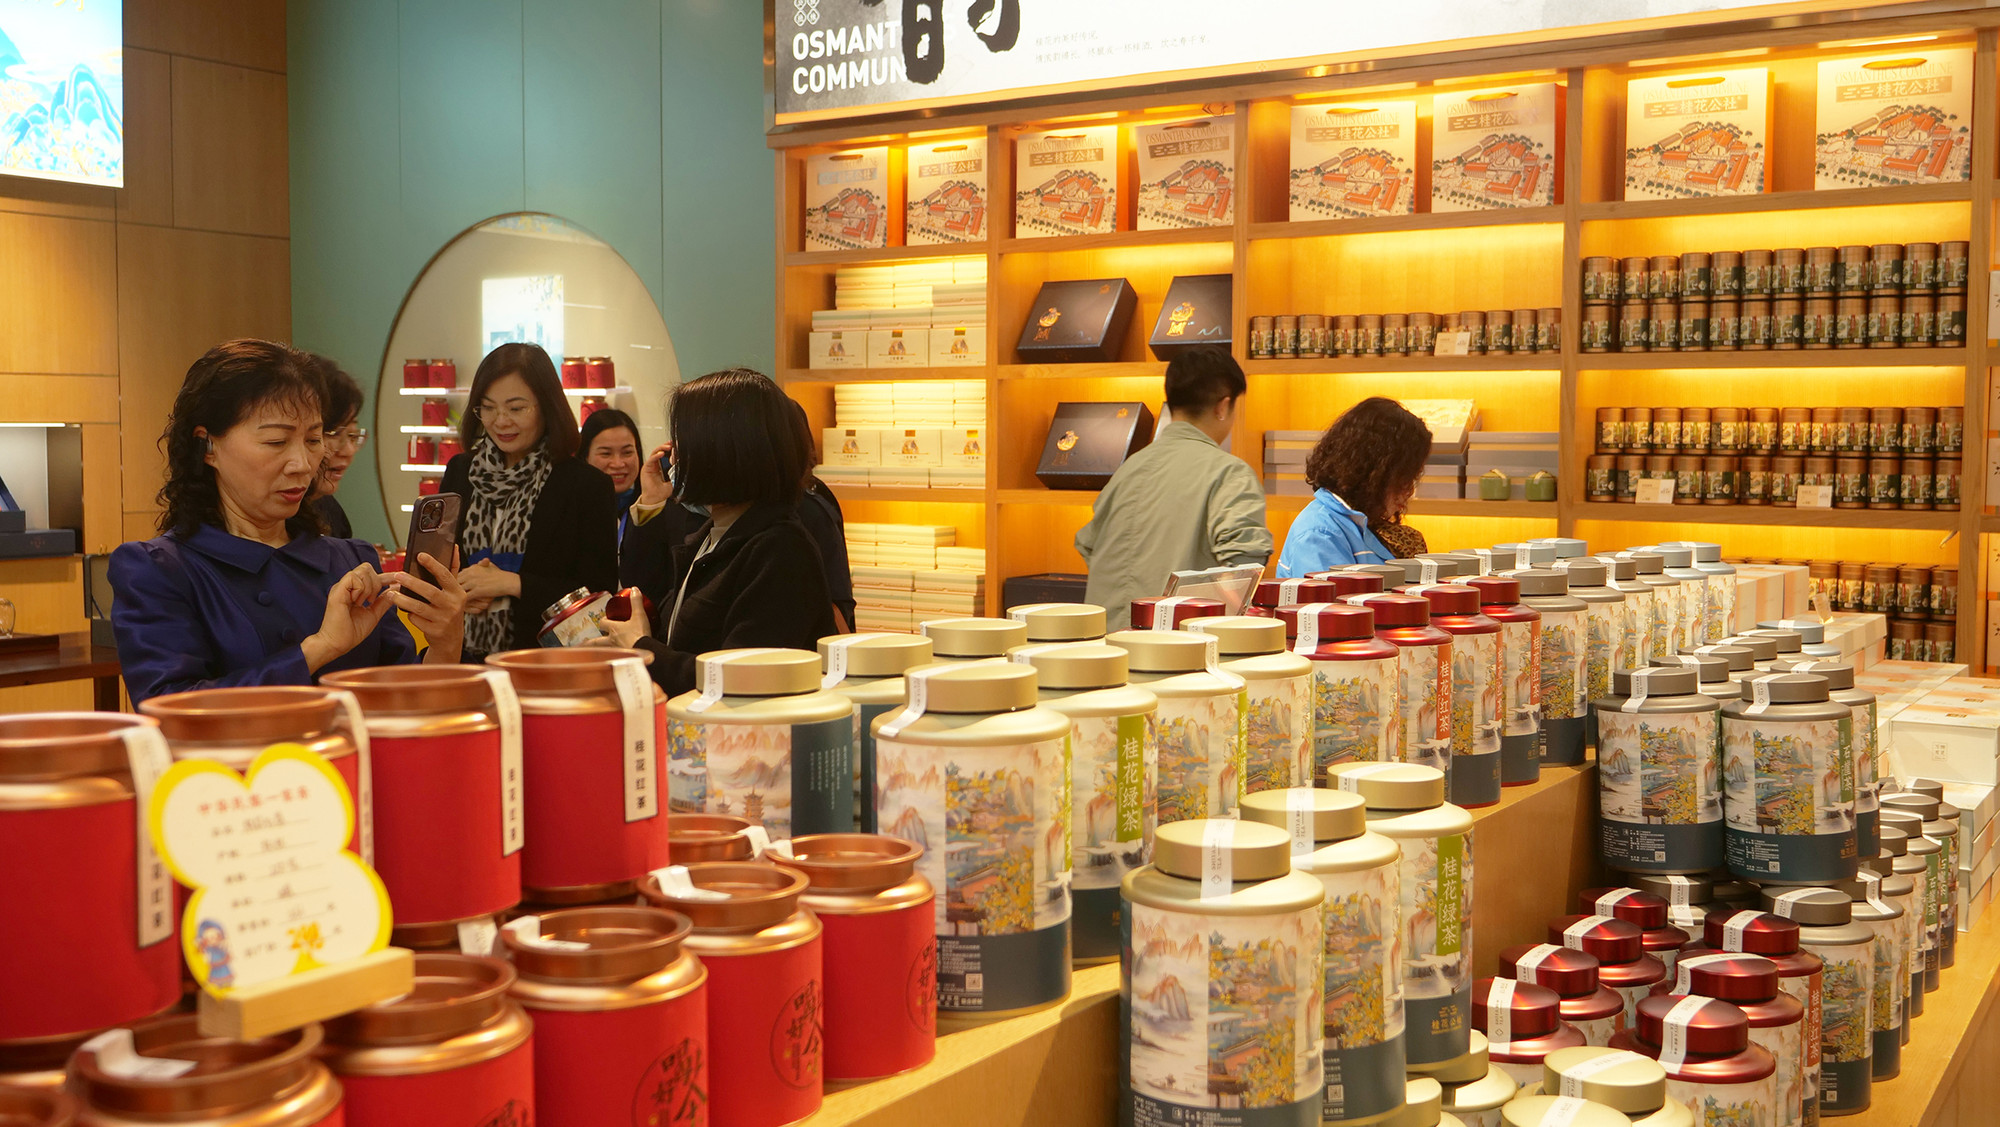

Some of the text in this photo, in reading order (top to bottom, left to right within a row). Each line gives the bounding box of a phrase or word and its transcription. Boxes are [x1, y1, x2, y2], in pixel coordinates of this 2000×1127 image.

[1439, 660, 1450, 732] 桂花红茶
[1121, 736, 1139, 832] 桂花绿茶
[1441, 856, 1458, 946] 桂花绿茶
